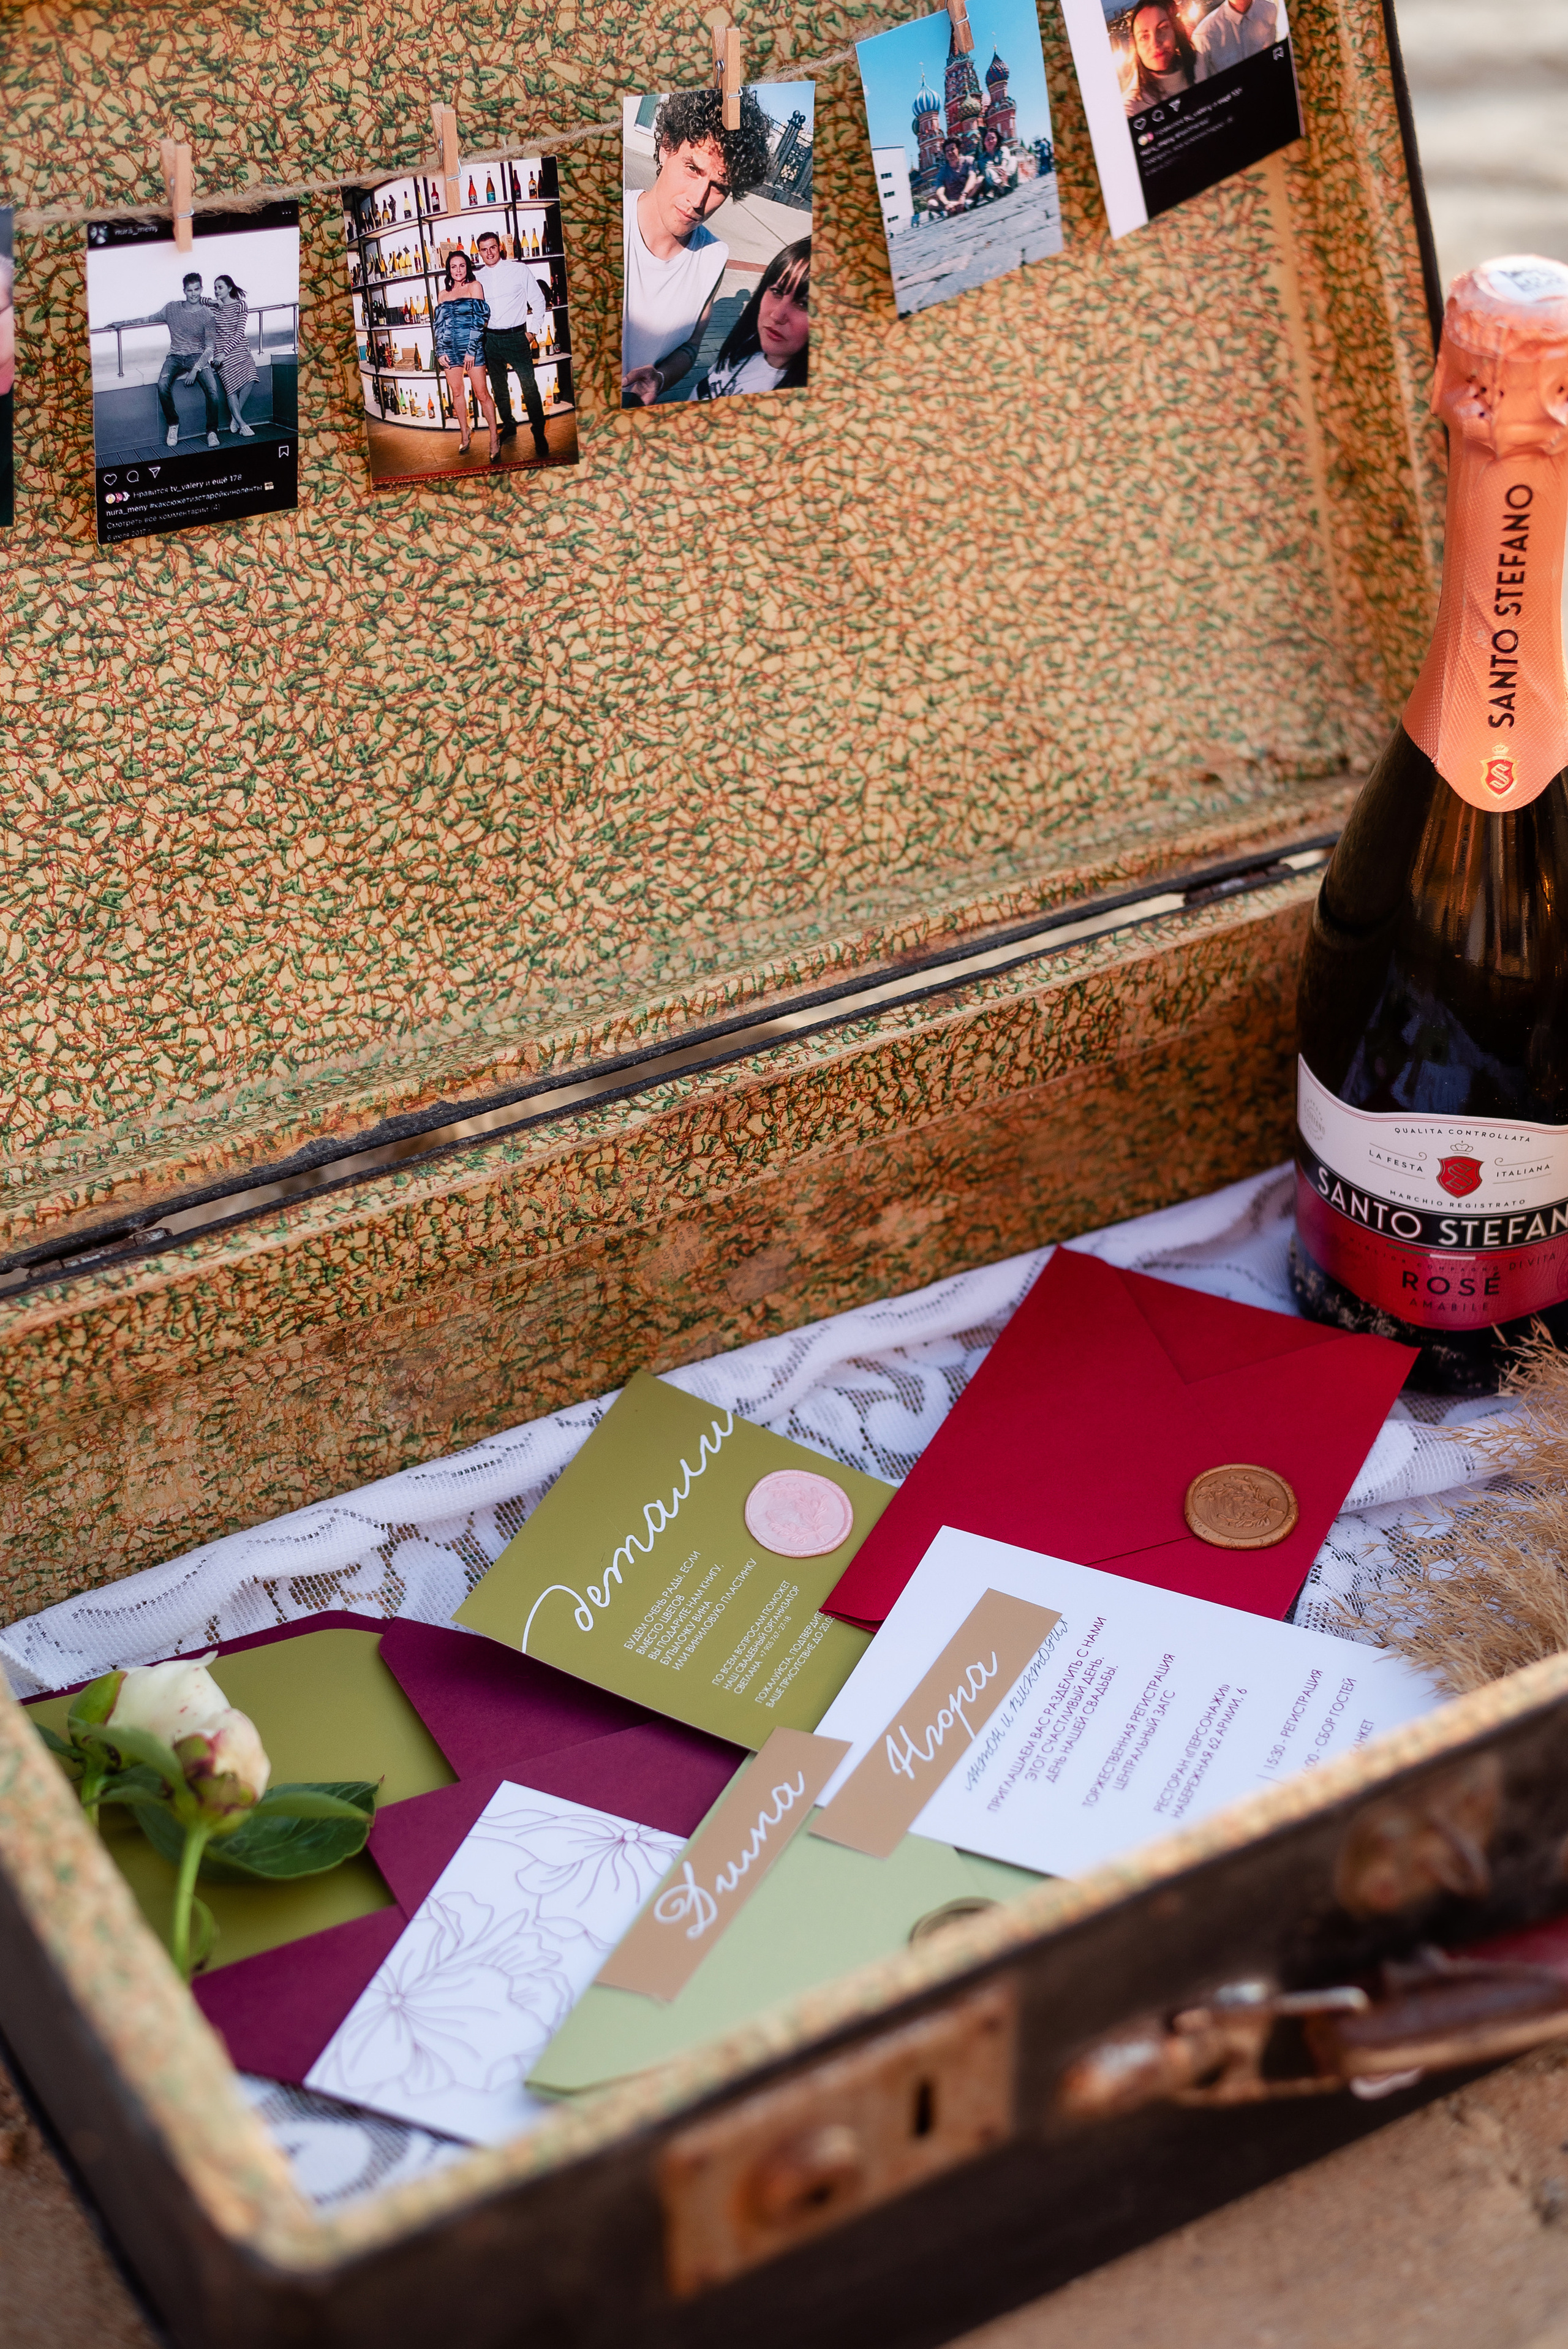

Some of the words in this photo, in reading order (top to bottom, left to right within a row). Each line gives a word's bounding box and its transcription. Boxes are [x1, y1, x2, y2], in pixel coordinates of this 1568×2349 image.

[106, 504, 148, 516] nura_meny
[107, 518, 142, 529] Смотреть
[159, 507, 209, 520] комментарии
[134, 488, 168, 498] Нравится
[170, 481, 204, 493] tv_valery
[212, 477, 228, 486] ещё
[131, 529, 146, 537] 2017
[1494, 484, 1533, 616] STEFANO
[1488, 629, 1519, 729] SANTO
[1369, 1149, 1382, 1160] LA
[1387, 1157, 1424, 1173] FESTA
[1448, 1129, 1531, 1143] CONTROLLATA
[1317, 1165, 1422, 1239] SANTO
[1390, 1189, 1444, 1206] MARCHIO
[1449, 1199, 1526, 1209] REGISTRATO
[1496, 1163, 1551, 1178] ITALIANA
[1402, 1270, 1501, 1296] ROSÉ
[1409, 1297, 1489, 1312] AMABILE
[624, 1623, 649, 1649] БУДЕМ
[644, 1599, 666, 1622] ОЧЕНЬ
[662, 1575, 685, 1598] РАДЫ,
[680, 1551, 701, 1573] ЕСЛИ
[636, 1624, 663, 1654] ВМЕСТО
[659, 1595, 684, 1623] ЦВЕТОВ
[648, 1647, 662, 1660] ВЫ
[657, 1607, 692, 1647] ПОДАРИТЕ
[686, 1589, 705, 1608] НАМ
[672, 1652, 690, 1670] ИЛИ
[685, 1604, 725, 1652] ВИНИЛОВУЮ
[721, 1558, 756, 1603] ПЛАСТИНКУ
[712, 1674, 724, 1685] ПО
[720, 1655, 739, 1674] ВСЕМ
[734, 1615, 767, 1655] ВОПРОСАМ
[762, 1580, 790, 1615] ПОМОЖЕТ
[1082, 1617, 1106, 1647] НАМИ
[660, 1621, 696, 1665] БУТЫЛОЧКУ
[692, 1602, 712, 1622] ВИНА
[723, 1673, 739, 1690] НАШ
[736, 1632, 768, 1672] СВАДЕБНЫЙ
[764, 1586, 799, 1632] ОРГАНИЗАТОР
[734, 1662, 763, 1693] СВЕТЛАНА
[760, 1649, 767, 1658] +7
[764, 1641, 774, 1651] 905
[778, 1616, 791, 1630] 27-18
[1077, 1649, 1088, 1657] С
[755, 1657, 794, 1703] ПОЖАЛУЙСТА,
[766, 1687, 784, 1708] ВАШЕ
[780, 1643, 816, 1688] ПРИСУТСТВИЕ
[812, 1632, 823, 1644] ДО
[1044, 1660, 1082, 1715] РАЗДЕЛИТЬ
[1025, 1754, 1047, 1780] ЭТОТ
[1042, 1685, 1087, 1752] СЧАСТЛИВЫЙ
[1082, 1657, 1104, 1685] ДЕНЬ.
[1030, 1717, 1050, 1738] ВАС
[1046, 1757, 1066, 1783] ДЕНЬ
[1060, 1716, 1088, 1753] НАШЕЙ
[1083, 1666, 1118, 1714] СВАДЬБЫ.
[1082, 1723, 1137, 1807] ТОРЖЕСТВЕННАЯ
[1130, 1654, 1175, 1722] РЕГИСТРАЦИЯ
[1114, 1718, 1160, 1790] ЦЕНТРАЛЬНЫЙ
[1153, 1690, 1175, 1715] ЗАГС
[1264, 1745, 1285, 1768] 15:30
[1281, 1670, 1322, 1737] РЕГИСТРАЦИЯ
[1315, 1717, 1335, 1746] СБОР
[1329, 1678, 1356, 1715] ГОСТЕЙ
[987, 1741, 1037, 1810] ПРИГЛАШАЕМ
[1154, 1759, 1190, 1812] РЕСТОРАН
[1171, 1750, 1215, 1818] НАБЕРЕЖНАЯ
[1208, 1738, 1221, 1749] 62
[1216, 1698, 1243, 1736] АРМИИ,
